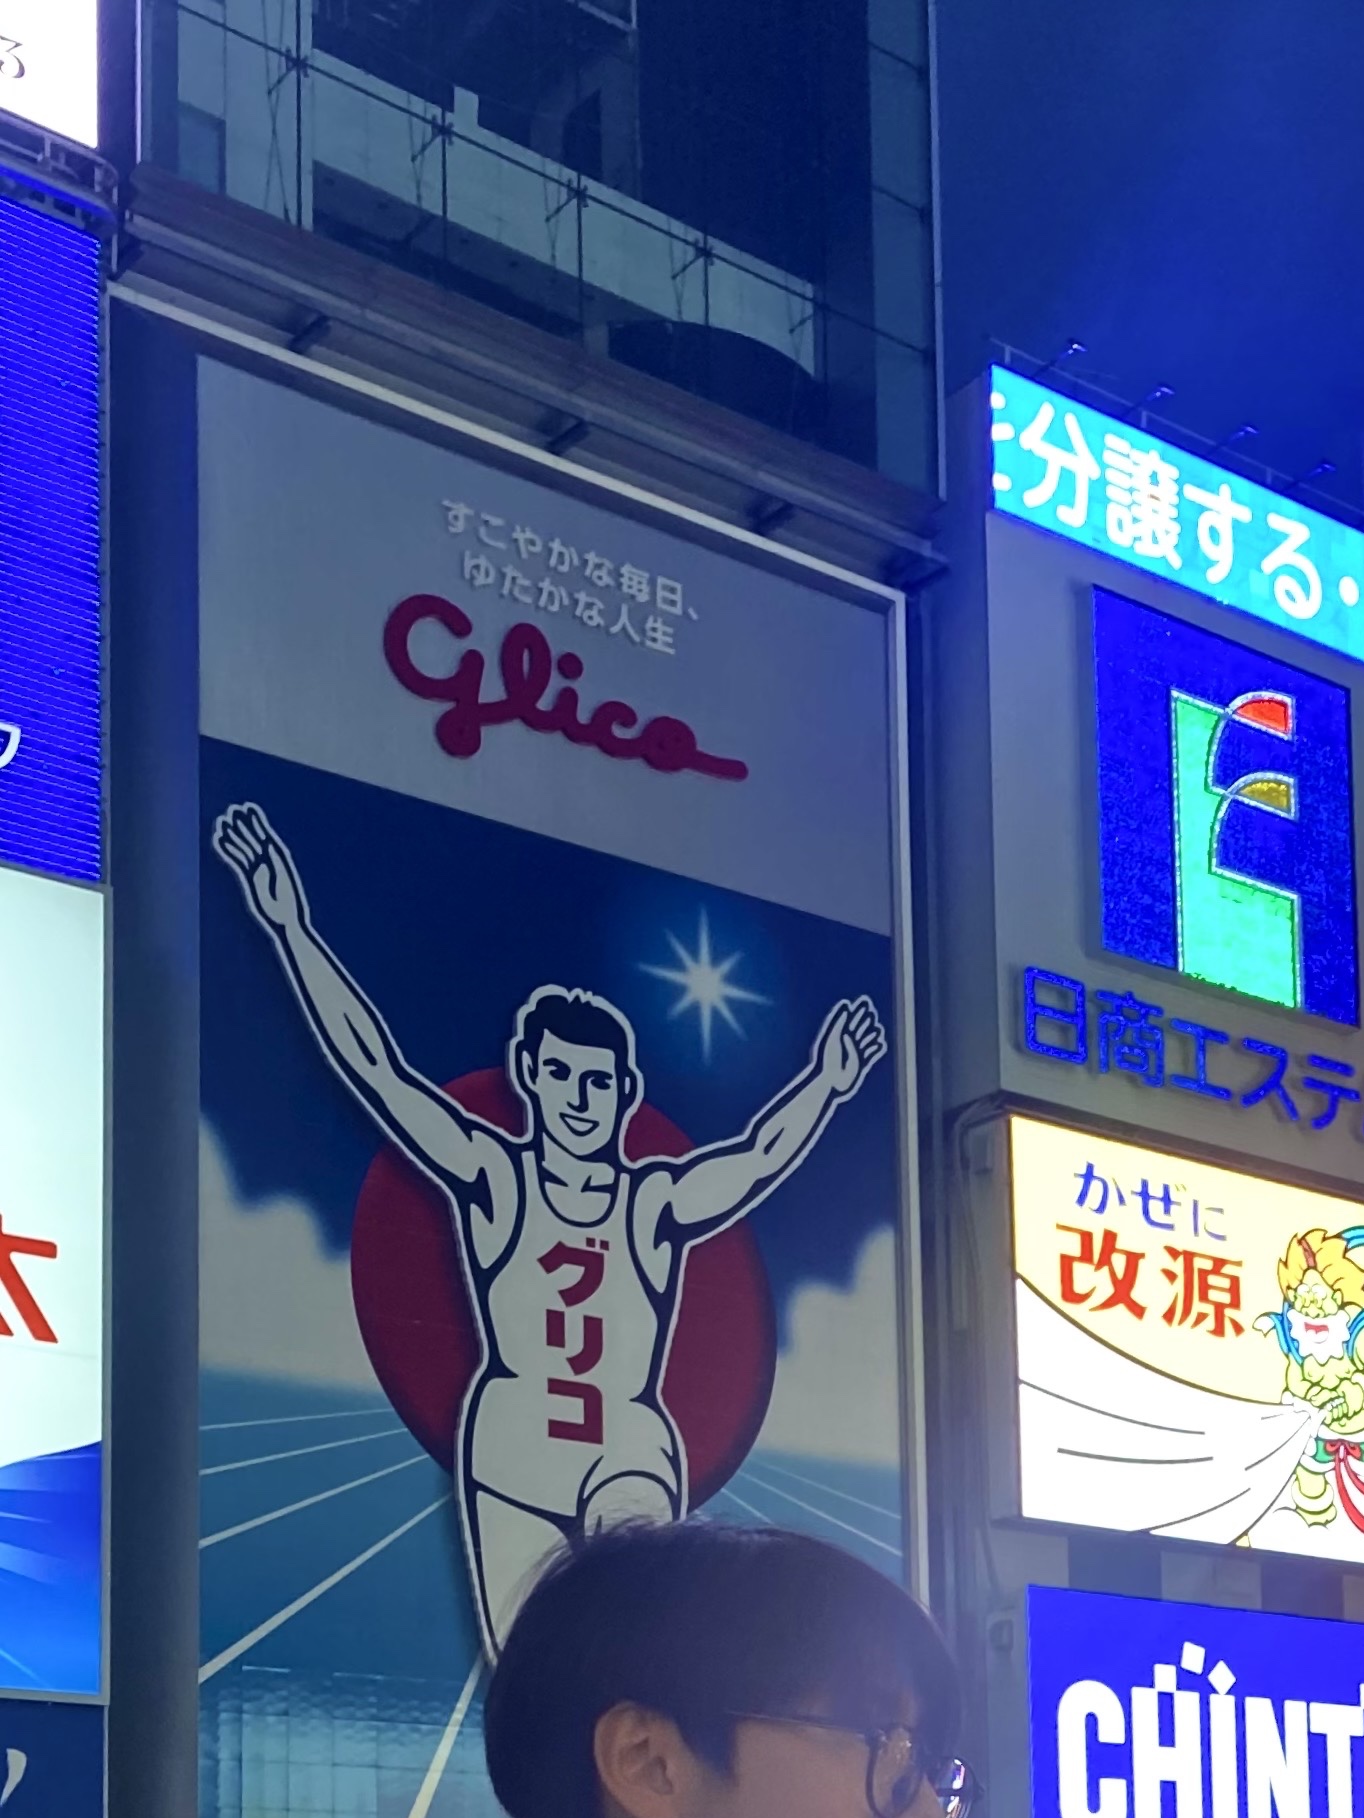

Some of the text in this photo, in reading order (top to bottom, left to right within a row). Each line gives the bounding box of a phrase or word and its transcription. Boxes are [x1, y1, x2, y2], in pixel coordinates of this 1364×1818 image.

[444, 498, 698, 621] すこやかな毎日、
[462, 549, 677, 655] ゆたかな人生
[384, 594, 748, 781] Glico
[1074, 1162, 1227, 1242] かぜに
[1056, 1223, 1245, 1338] 改源
[536, 1236, 609, 1447] グリコ
